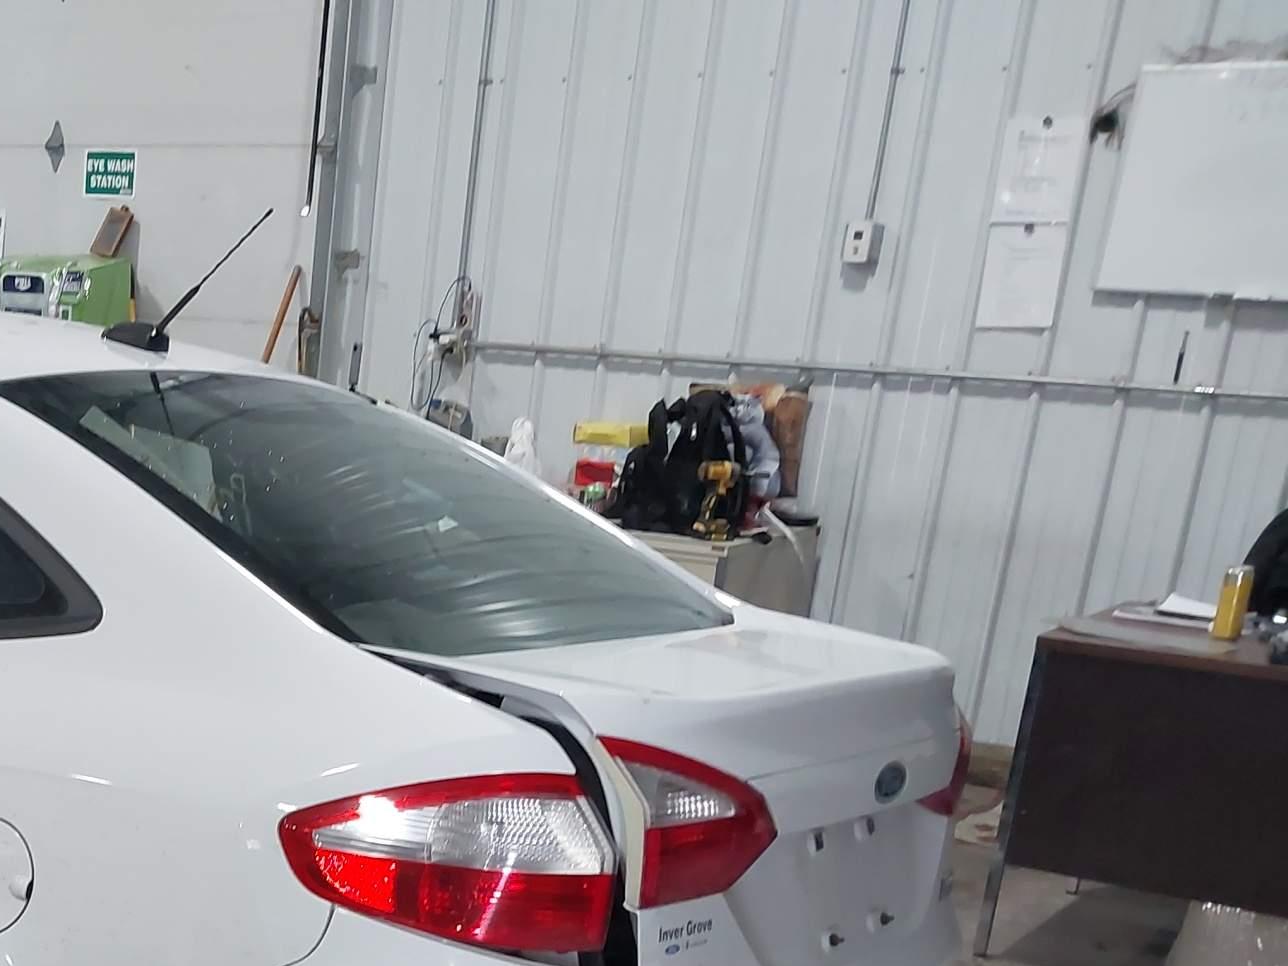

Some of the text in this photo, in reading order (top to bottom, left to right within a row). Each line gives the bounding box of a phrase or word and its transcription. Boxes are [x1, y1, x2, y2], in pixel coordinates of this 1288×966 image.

[87, 158, 133, 173] EYE WASH
[90, 174, 129, 189] STATION
[658, 919, 712, 943] Inver Grove
